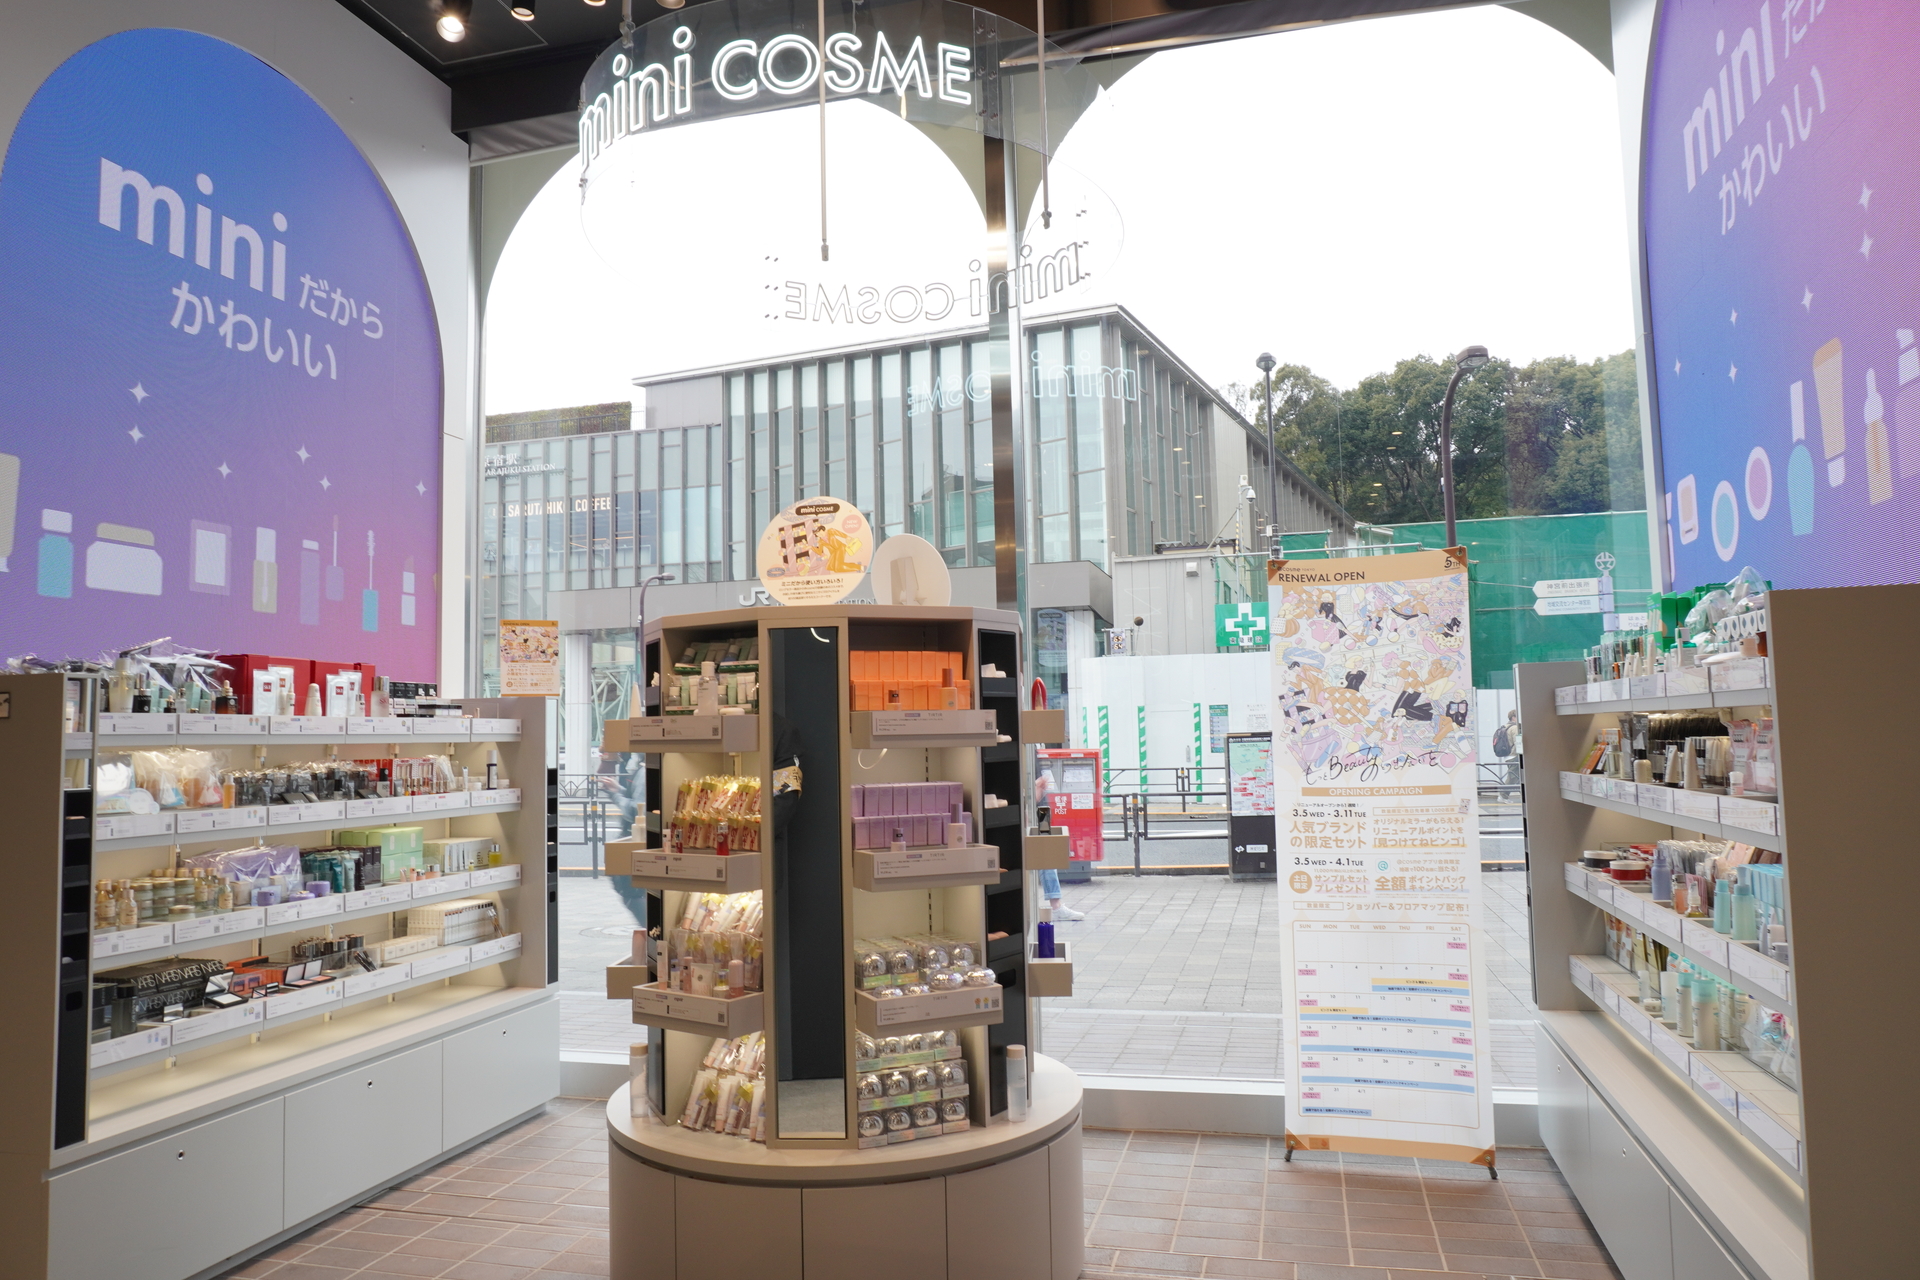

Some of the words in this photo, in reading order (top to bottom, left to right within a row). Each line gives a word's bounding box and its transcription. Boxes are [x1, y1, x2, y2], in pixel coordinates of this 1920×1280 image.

[578, 25, 694, 171] mini
[710, 31, 973, 106] COSME
[1718, 64, 1827, 236] かわいい
[97, 156, 290, 302] mini
[298, 272, 385, 341] だから
[169, 280, 339, 381] かわいい
[522, 462, 556, 474] STATION
[1278, 572, 1331, 583] RENEWAL
[1333, 571, 1366, 582] OPEN
[738, 586, 771, 607] JR
[1328, 787, 1371, 797] OPENING
[1372, 786, 1424, 796] CAMPAIGN
[1292, 808, 1308, 818] 3.5
[1333, 809, 1353, 818] 3.11
[1289, 820, 1367, 834] 人気ブランド
[1372, 826, 1464, 836] リニューアルポイントを
[1290, 835, 1367, 849] の限定セット
[1373, 836, 1466, 848] 「見つけてねビンゴ」
[1294, 856, 1310, 866] 3.5
[1335, 857, 1350, 866] 4.1
[1293, 874, 1309, 882] 土日
[1314, 875, 1369, 883] サンプルセット
[1374, 875, 1407, 891] 全額
[1408, 875, 1466, 884] ポイントバック
[1314, 884, 1368, 894] プレゼント!
[1408, 884, 1465, 893] キャンペーン!
